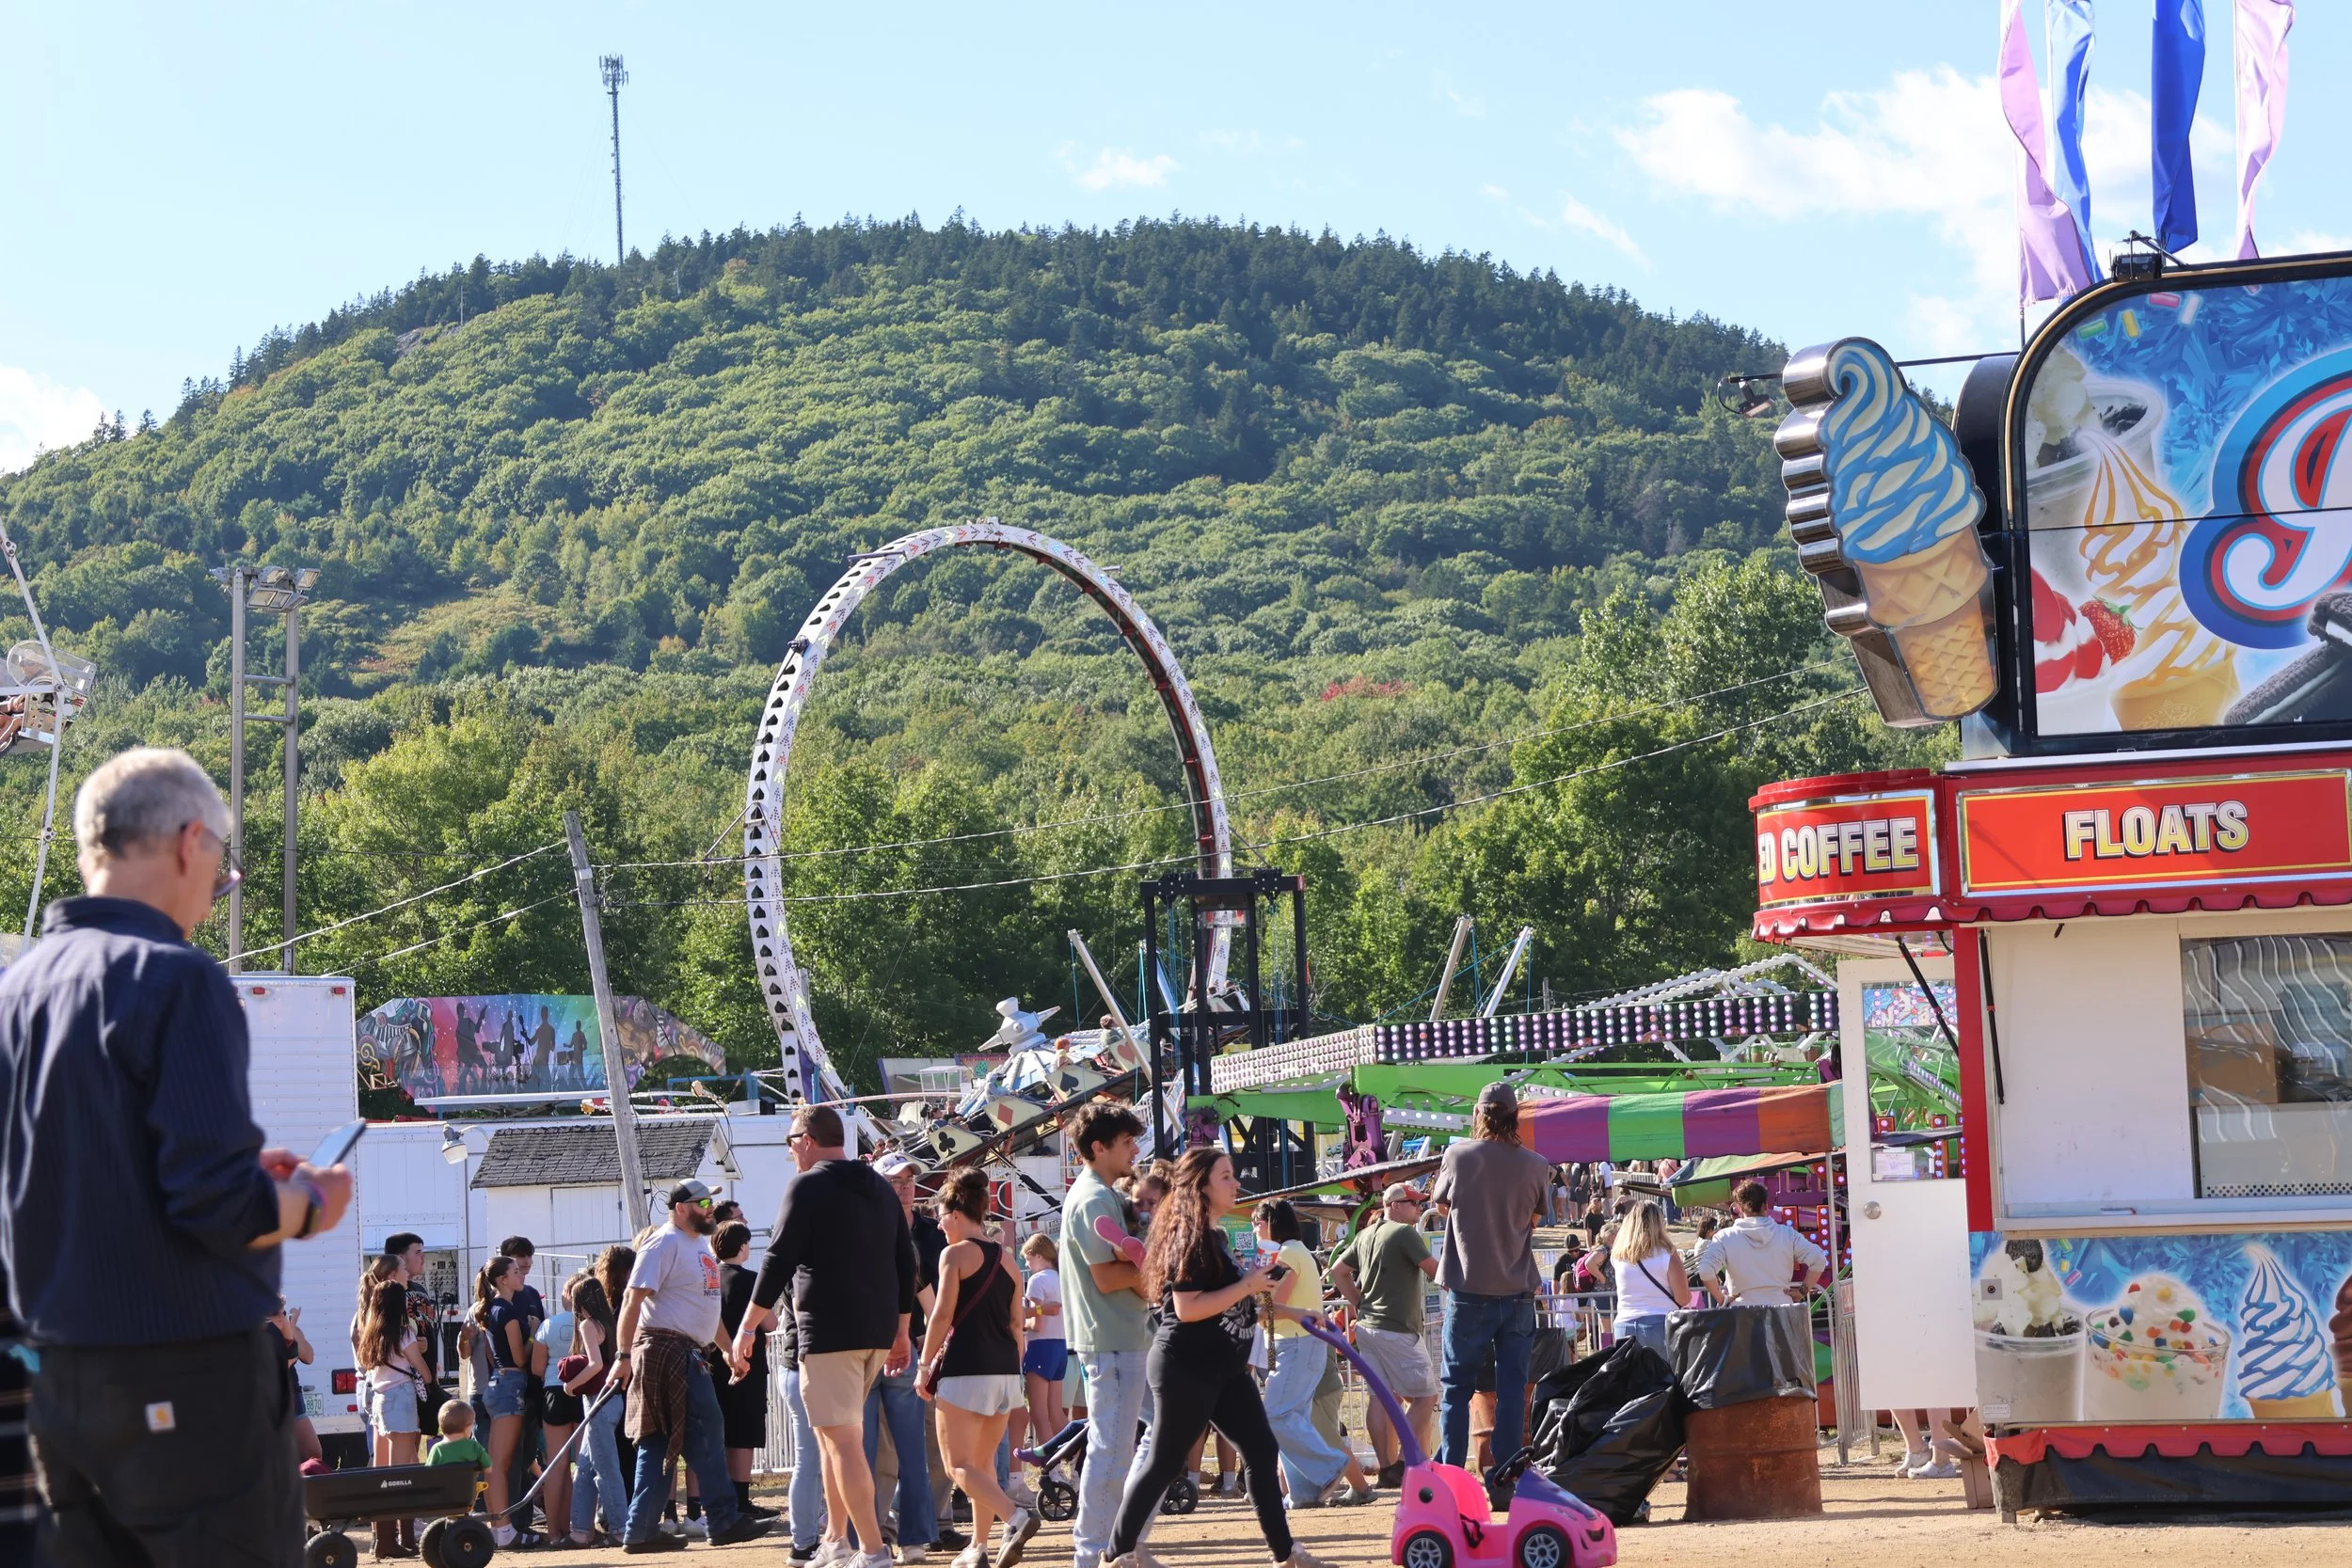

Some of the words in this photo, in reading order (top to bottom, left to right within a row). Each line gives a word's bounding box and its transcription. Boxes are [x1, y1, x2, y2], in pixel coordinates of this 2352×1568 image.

[1757, 832, 1777, 887] ED
[1781, 816, 1919, 882] COFFEE
[2063, 800, 2249, 862] FLOATS
